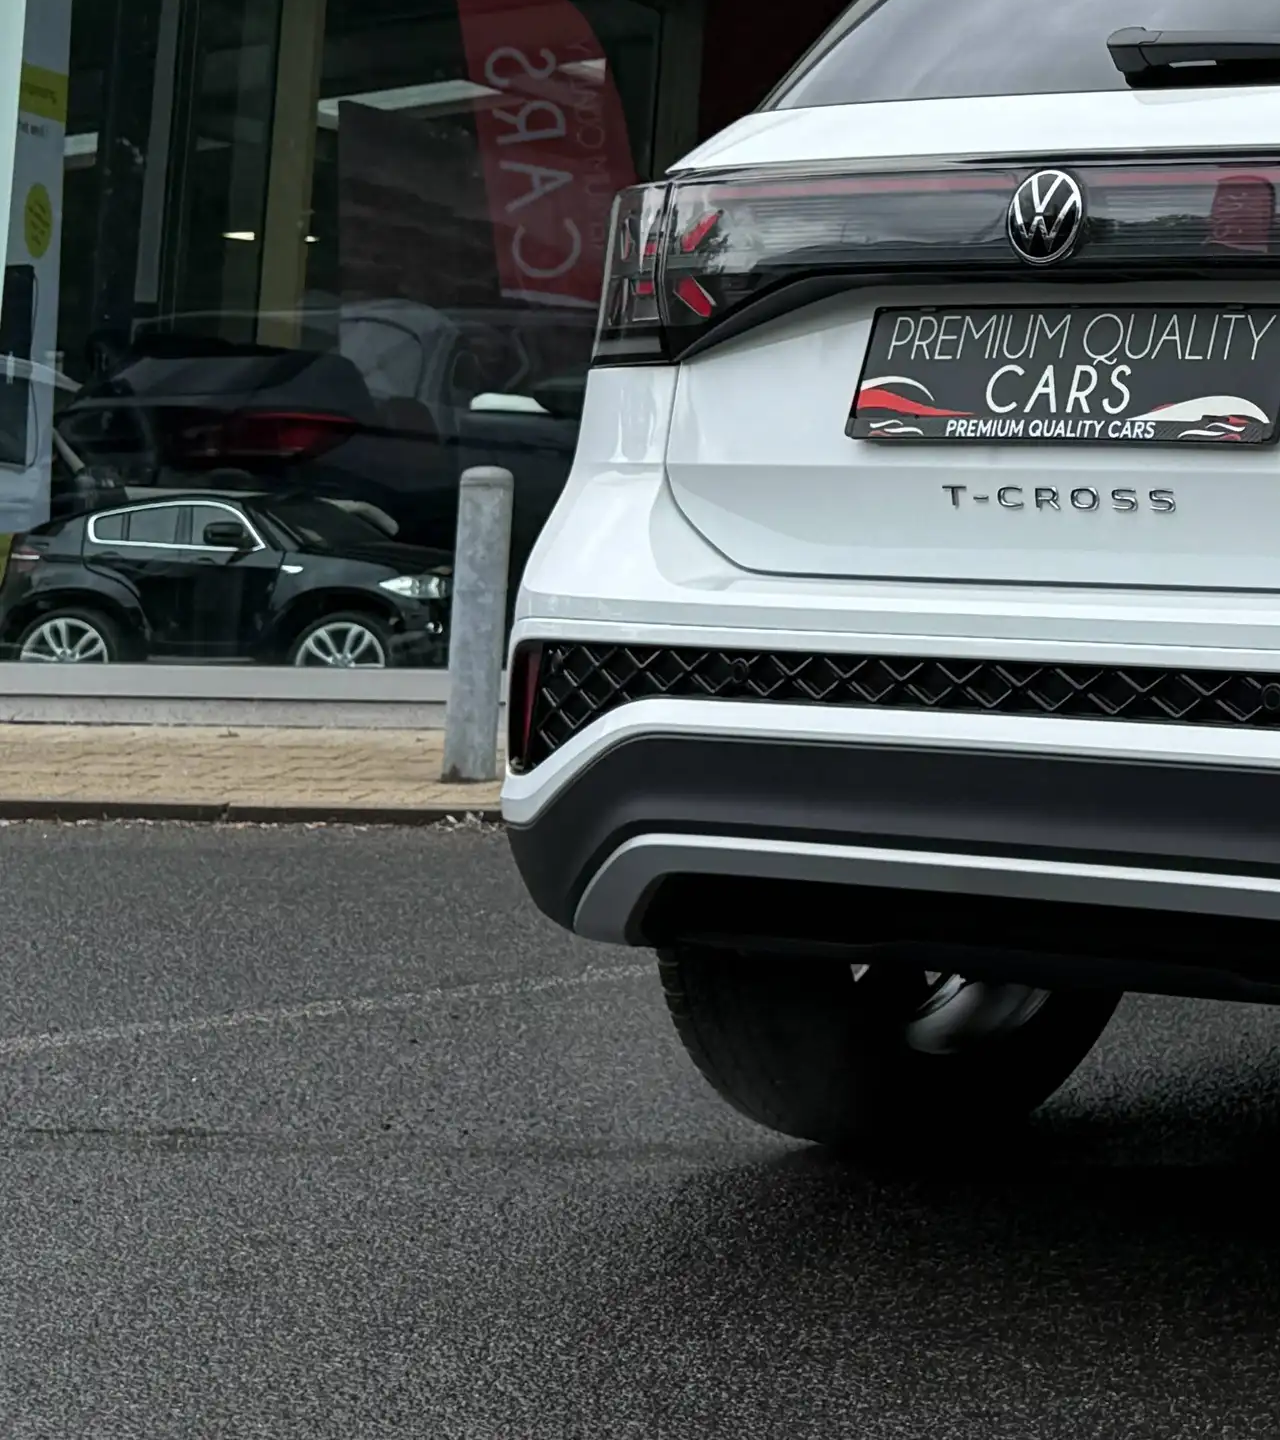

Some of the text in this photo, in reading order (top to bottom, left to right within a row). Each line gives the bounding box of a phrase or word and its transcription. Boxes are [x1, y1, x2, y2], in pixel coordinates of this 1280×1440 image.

[887, 312, 1278, 365] PREMIUM QUALITY
[985, 363, 1132, 415] CARS
[945, 419, 1156, 439] PREMIUM QUALITY CARS
[941, 483, 1178, 514] T-CROSS
